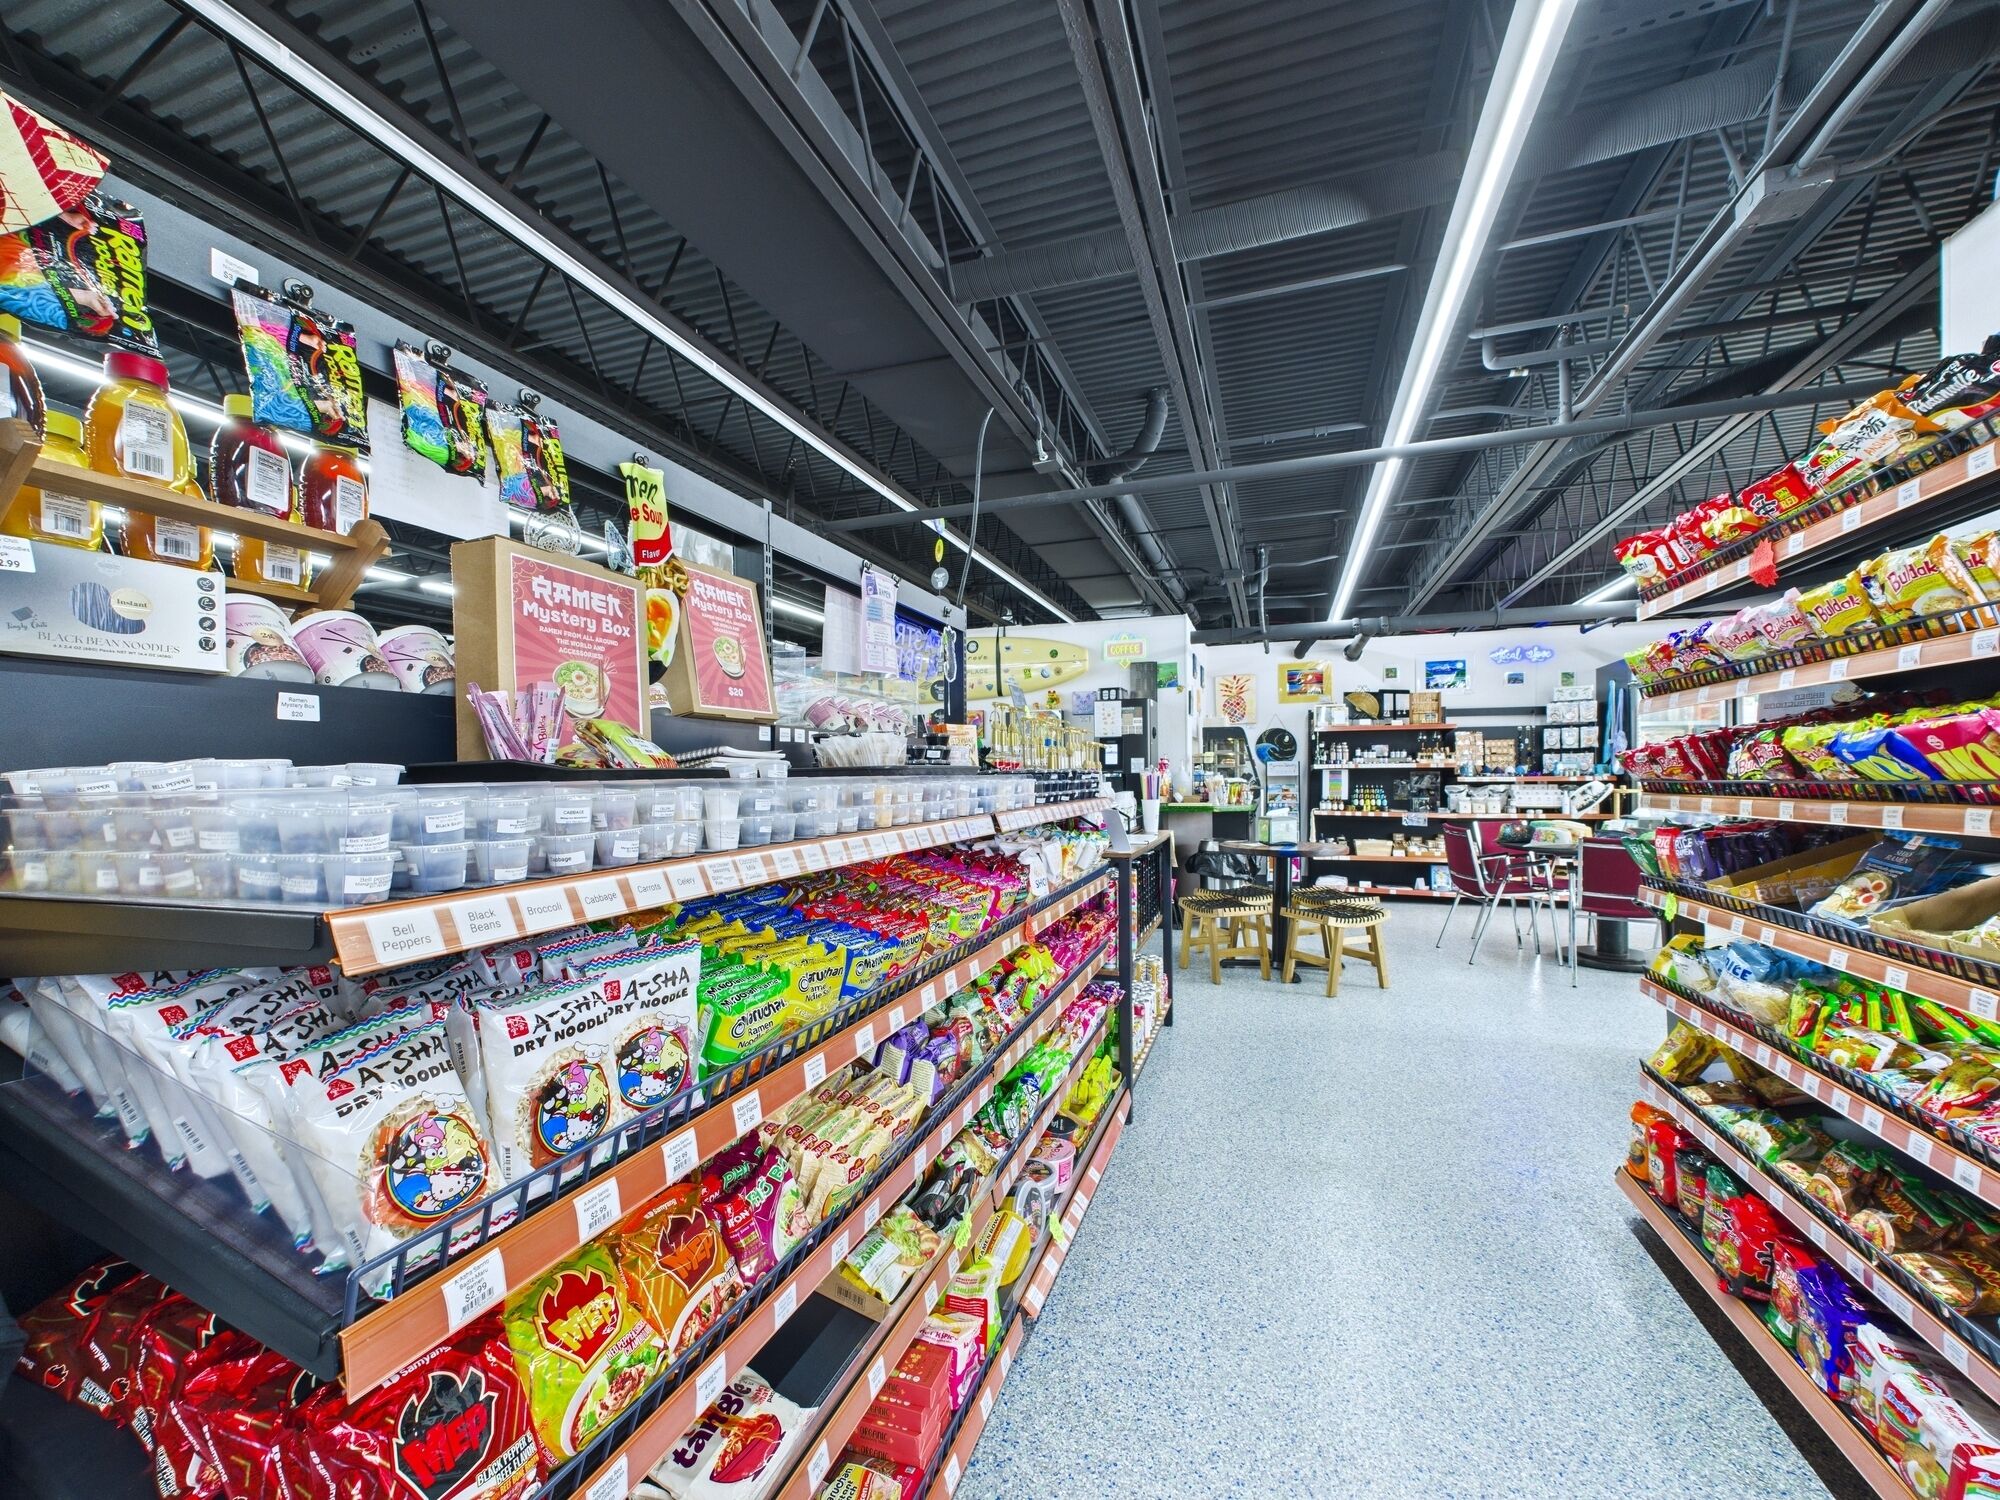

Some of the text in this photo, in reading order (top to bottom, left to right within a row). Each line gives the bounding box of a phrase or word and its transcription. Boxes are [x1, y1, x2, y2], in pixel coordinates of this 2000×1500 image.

[642, 503, 663, 529] Soup
[1886, 564, 1938, 593] Buldak
[116, 599, 148, 608] Instant
[531, 574, 623, 618] RAMEN
[693, 579, 747, 609] RAMEN
[522, 600, 631, 637] Mystery Box
[691, 595, 753, 623] Mystery Box
[1815, 595, 1862, 623] Buldak
[539, 625, 619, 646] RAMEN FROM ALL AROUND
[1719, 626, 1758, 652] Buldak
[1763, 615, 1803, 640] Buldak
[37, 631, 181, 653] BLACK BEAN NOODLES
[570, 640, 592, 649] WORLD
[593, 644, 606, 652] AND
[1110, 643, 1141, 654] COFFEE
[728, 686, 744, 697] $20
[1674, 837, 1693, 850] RICE
[636, 882, 662, 894] Carrots
[676, 876, 696, 888] Celery
[526, 902, 563, 916] Broccoli
[584, 891, 618, 905] Cabbage
[468, 908, 496, 921] Black
[470, 919, 502, 933] Beans
[382, 934, 432, 951] Peppers
[392, 924, 415, 936] Bell
[623, 966, 691, 1001] A-SHA
[532, 990, 607, 1034] A-SHA
[639, 988, 689, 1010] NOODLE
[748, 1020, 774, 1037] Ramen
[513, 1035, 548, 1057] DRY
[359, 1034, 447, 1088] A-SHA
[335, 1058, 453, 1118] DRY NOODLE
[591, 1204, 607, 1220] $2.99
[660, 1228, 713, 1279] MEP
[856, 1237, 886, 1269] RAMEN
[465, 1282, 487, 1302] $2.99
[547, 1292, 617, 1352] MEP
[399, 1345, 452, 1379] Samyang
[175, 1415, 200, 1451] Samyang
[673, 1381, 752, 1468] tangle
[860, 1426, 888, 1441] ORGANIC
[400, 1402, 489, 1488] MEP
[208, 1438, 230, 1483] Samyang
[477, 1431, 533, 1487] BLACK PEPPER &
[496, 1443, 537, 1484] BEEF FLAVOR
[276, 1462, 291, 1500] Samyan
[827, 1468, 853, 1500] aruchan
